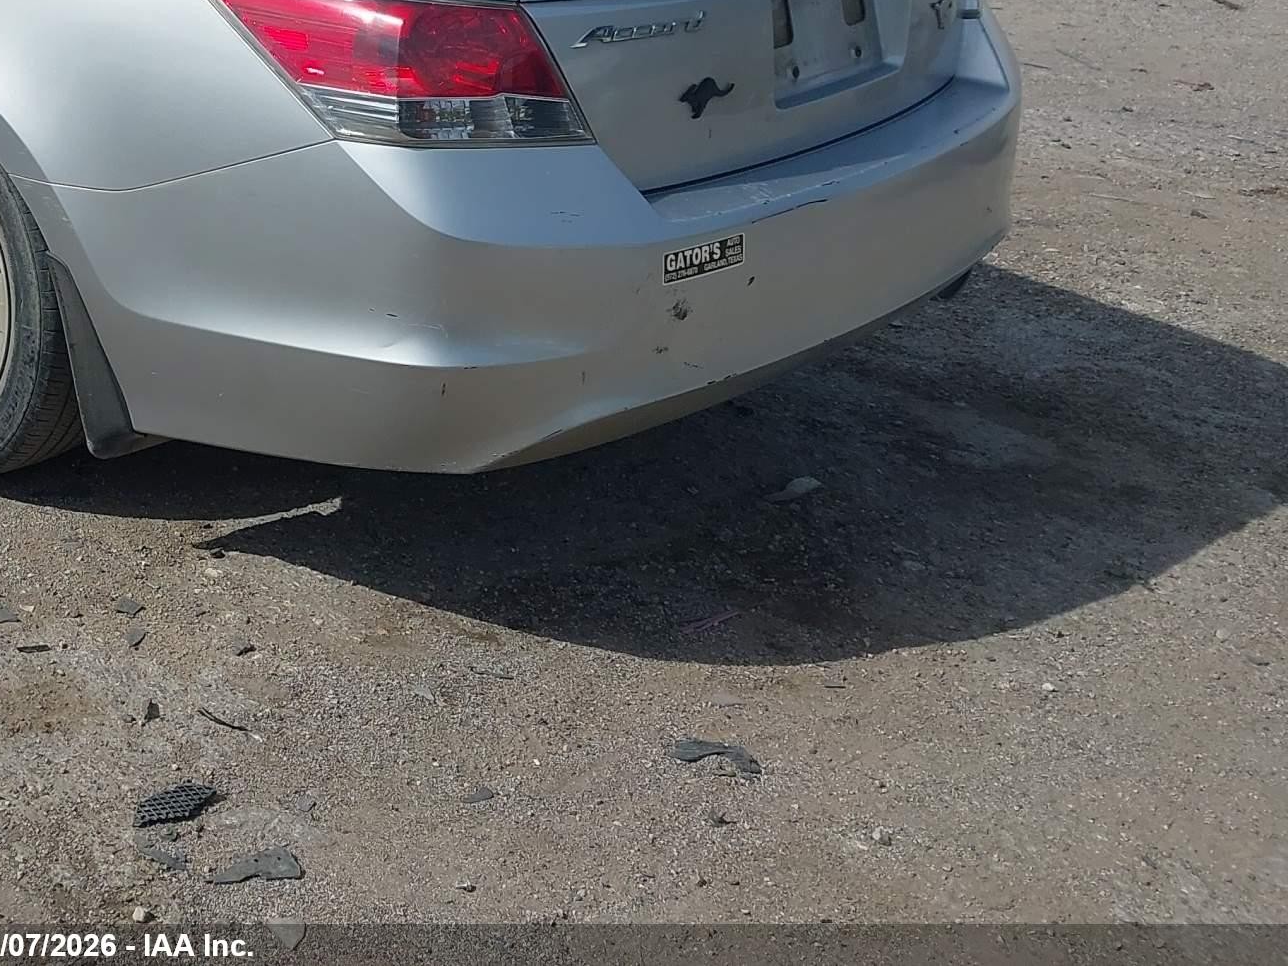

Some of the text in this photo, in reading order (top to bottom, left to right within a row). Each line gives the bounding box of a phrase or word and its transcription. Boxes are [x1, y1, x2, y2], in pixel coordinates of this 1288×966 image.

[569, 10, 706, 49] Accord
[726, 236, 741, 247] AUTO
[666, 242, 721, 272] GATOR'S
[725, 245, 742, 257] SALES
[728, 254, 743, 264] TEXAS
